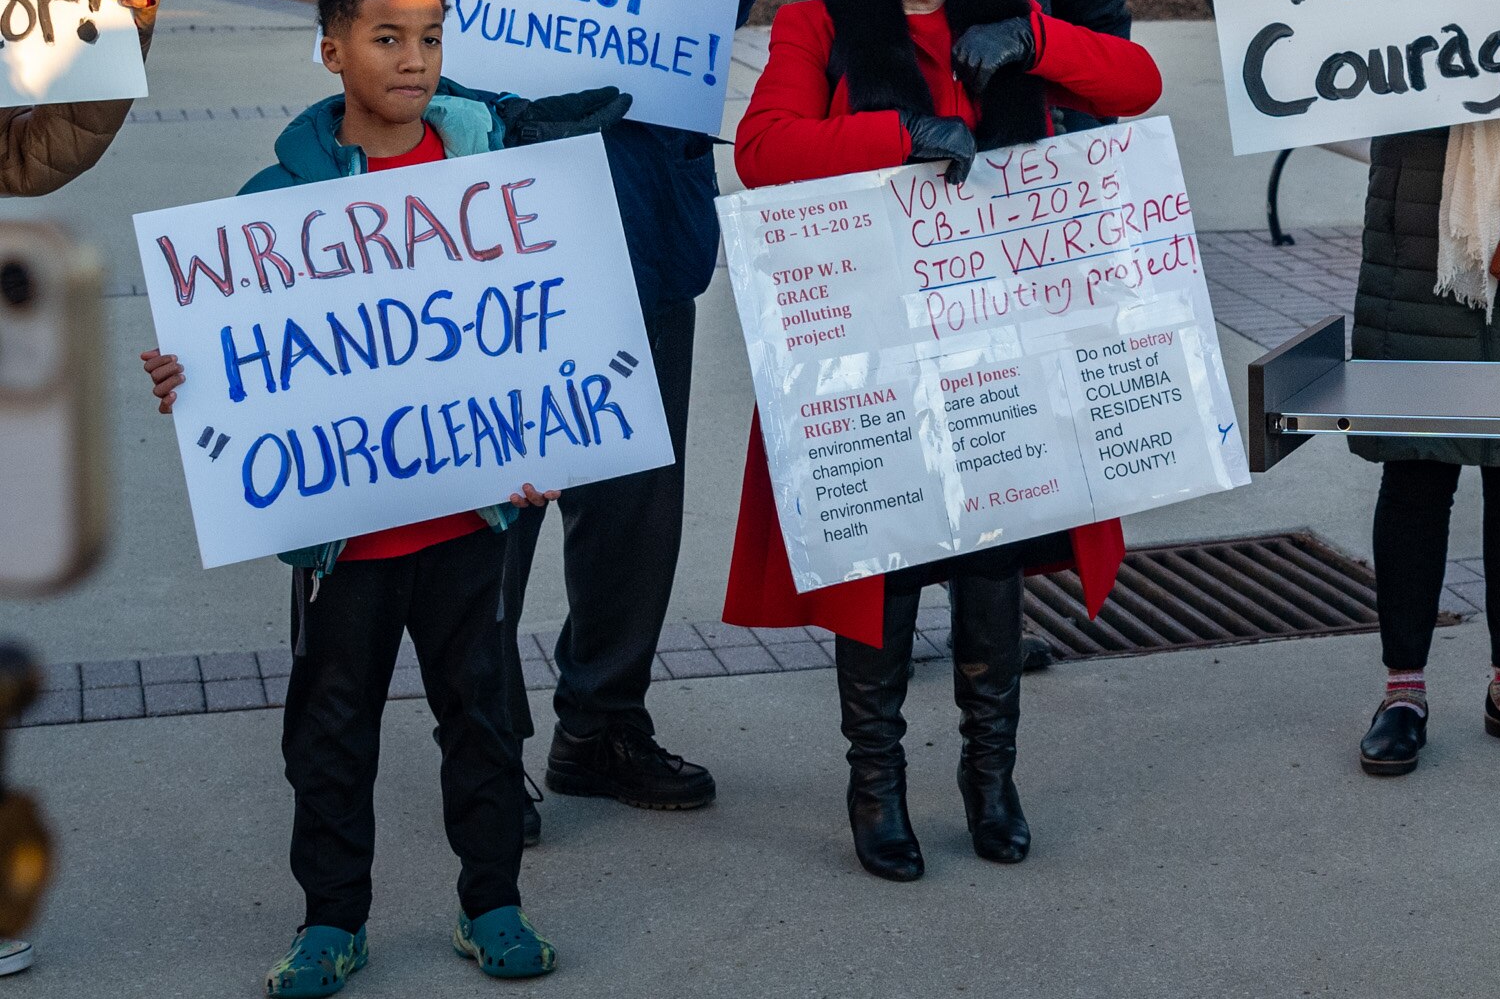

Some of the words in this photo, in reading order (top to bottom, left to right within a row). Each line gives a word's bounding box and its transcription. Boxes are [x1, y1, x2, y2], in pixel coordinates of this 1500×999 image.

[986, 145, 1059, 199] YES
[1087, 126, 1132, 167] ON
[761, 208, 796, 223] Vote
[798, 203, 825, 221] yes
[828, 200, 849, 212] on
[764, 228, 786, 244] CB
[772, 266, 814, 286] STOP
[817, 262, 839, 278] W.
[841, 259, 857, 273] R.
[914, 250, 985, 288] STOP
[1086, 233, 1198, 306] project!
[777, 284, 829, 306] GRACE
[781, 304, 852, 330] polluting
[220, 277, 566, 402] HANDS-OFF
[786, 324, 846, 351] project!
[1076, 348, 1098, 363] Do
[1102, 340, 1127, 357] not
[1129, 331, 1174, 351] betray
[940, 372, 974, 393] Opel
[977, 365, 1021, 387] Jones:
[1081, 368, 1105, 383] the
[1108, 357, 1142, 376] trust
[1146, 351, 1159, 367] of
[944, 398, 975, 412] care
[979, 384, 1020, 405] about
[1086, 370, 1171, 401] COLUMBIA
[800, 388, 897, 418] CHRISTIANA
[947, 403, 1038, 432] communities
[1090, 388, 1182, 421] RESIDENTS
[803, 417, 857, 439] RIGBY:
[859, 413, 882, 430] Be
[886, 409, 906, 423] an
[1095, 422, 1124, 442] and
[808, 426, 913, 460] environmental
[952, 436, 967, 453] of
[969, 430, 1006, 449] color
[1098, 431, 1173, 461] HOWARD
[812, 456, 884, 480] champion
[955, 445, 1023, 473] impacted
[1025, 442, 1048, 459] by:
[1104, 450, 1177, 480] COUNTY!
[815, 478, 869, 501] Protect
[820, 488, 924, 522] environmental
[823, 522, 868, 543] health
